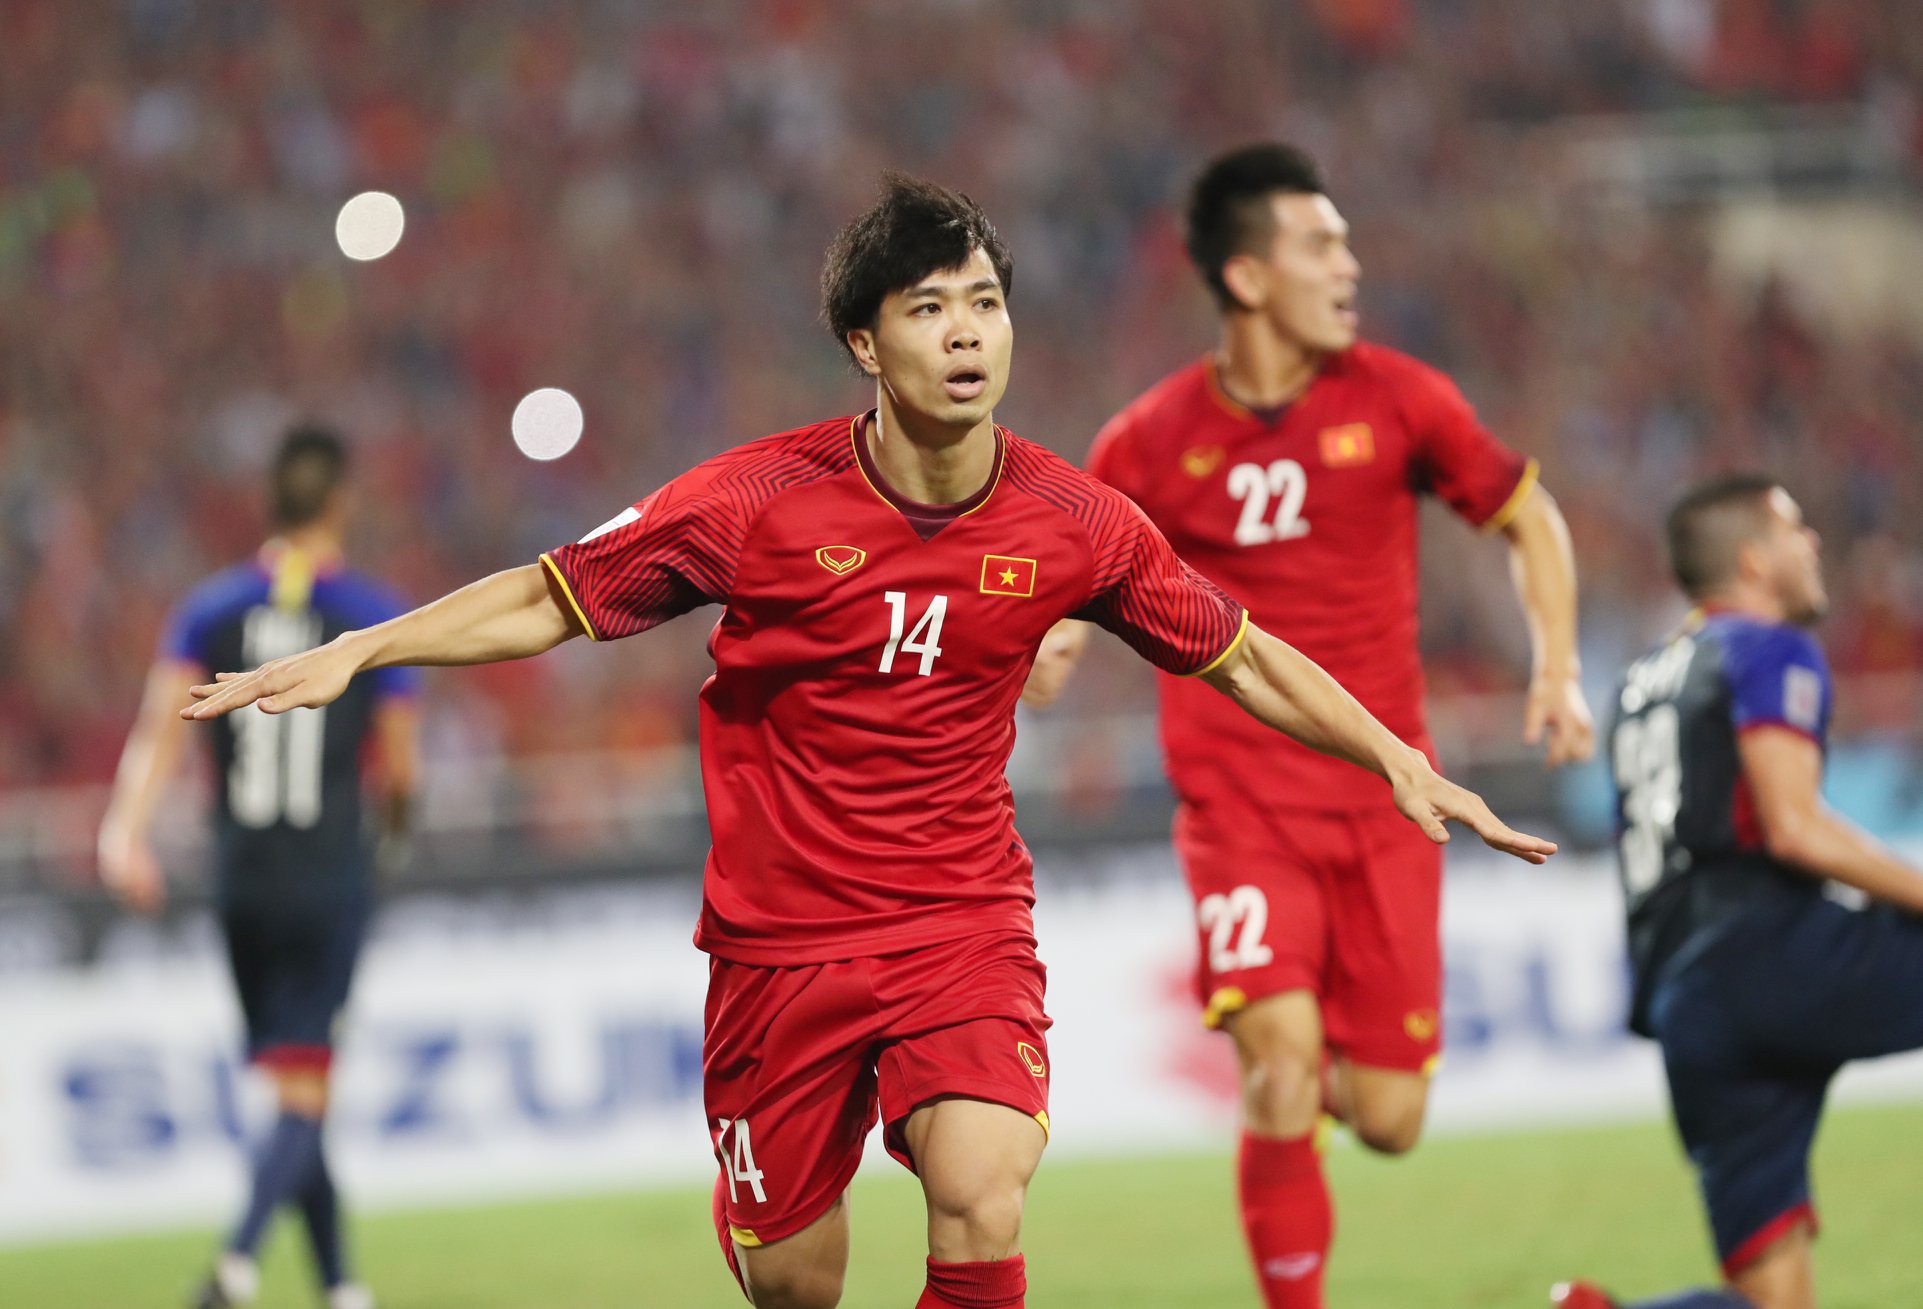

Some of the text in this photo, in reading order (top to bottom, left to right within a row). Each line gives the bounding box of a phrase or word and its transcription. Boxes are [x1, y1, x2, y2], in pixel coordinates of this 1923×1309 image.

[1226, 459, 1310, 546] 22
[879, 590, 949, 677] 14
[1199, 884, 1274, 973] 22
[718, 1117, 765, 1203] 14
